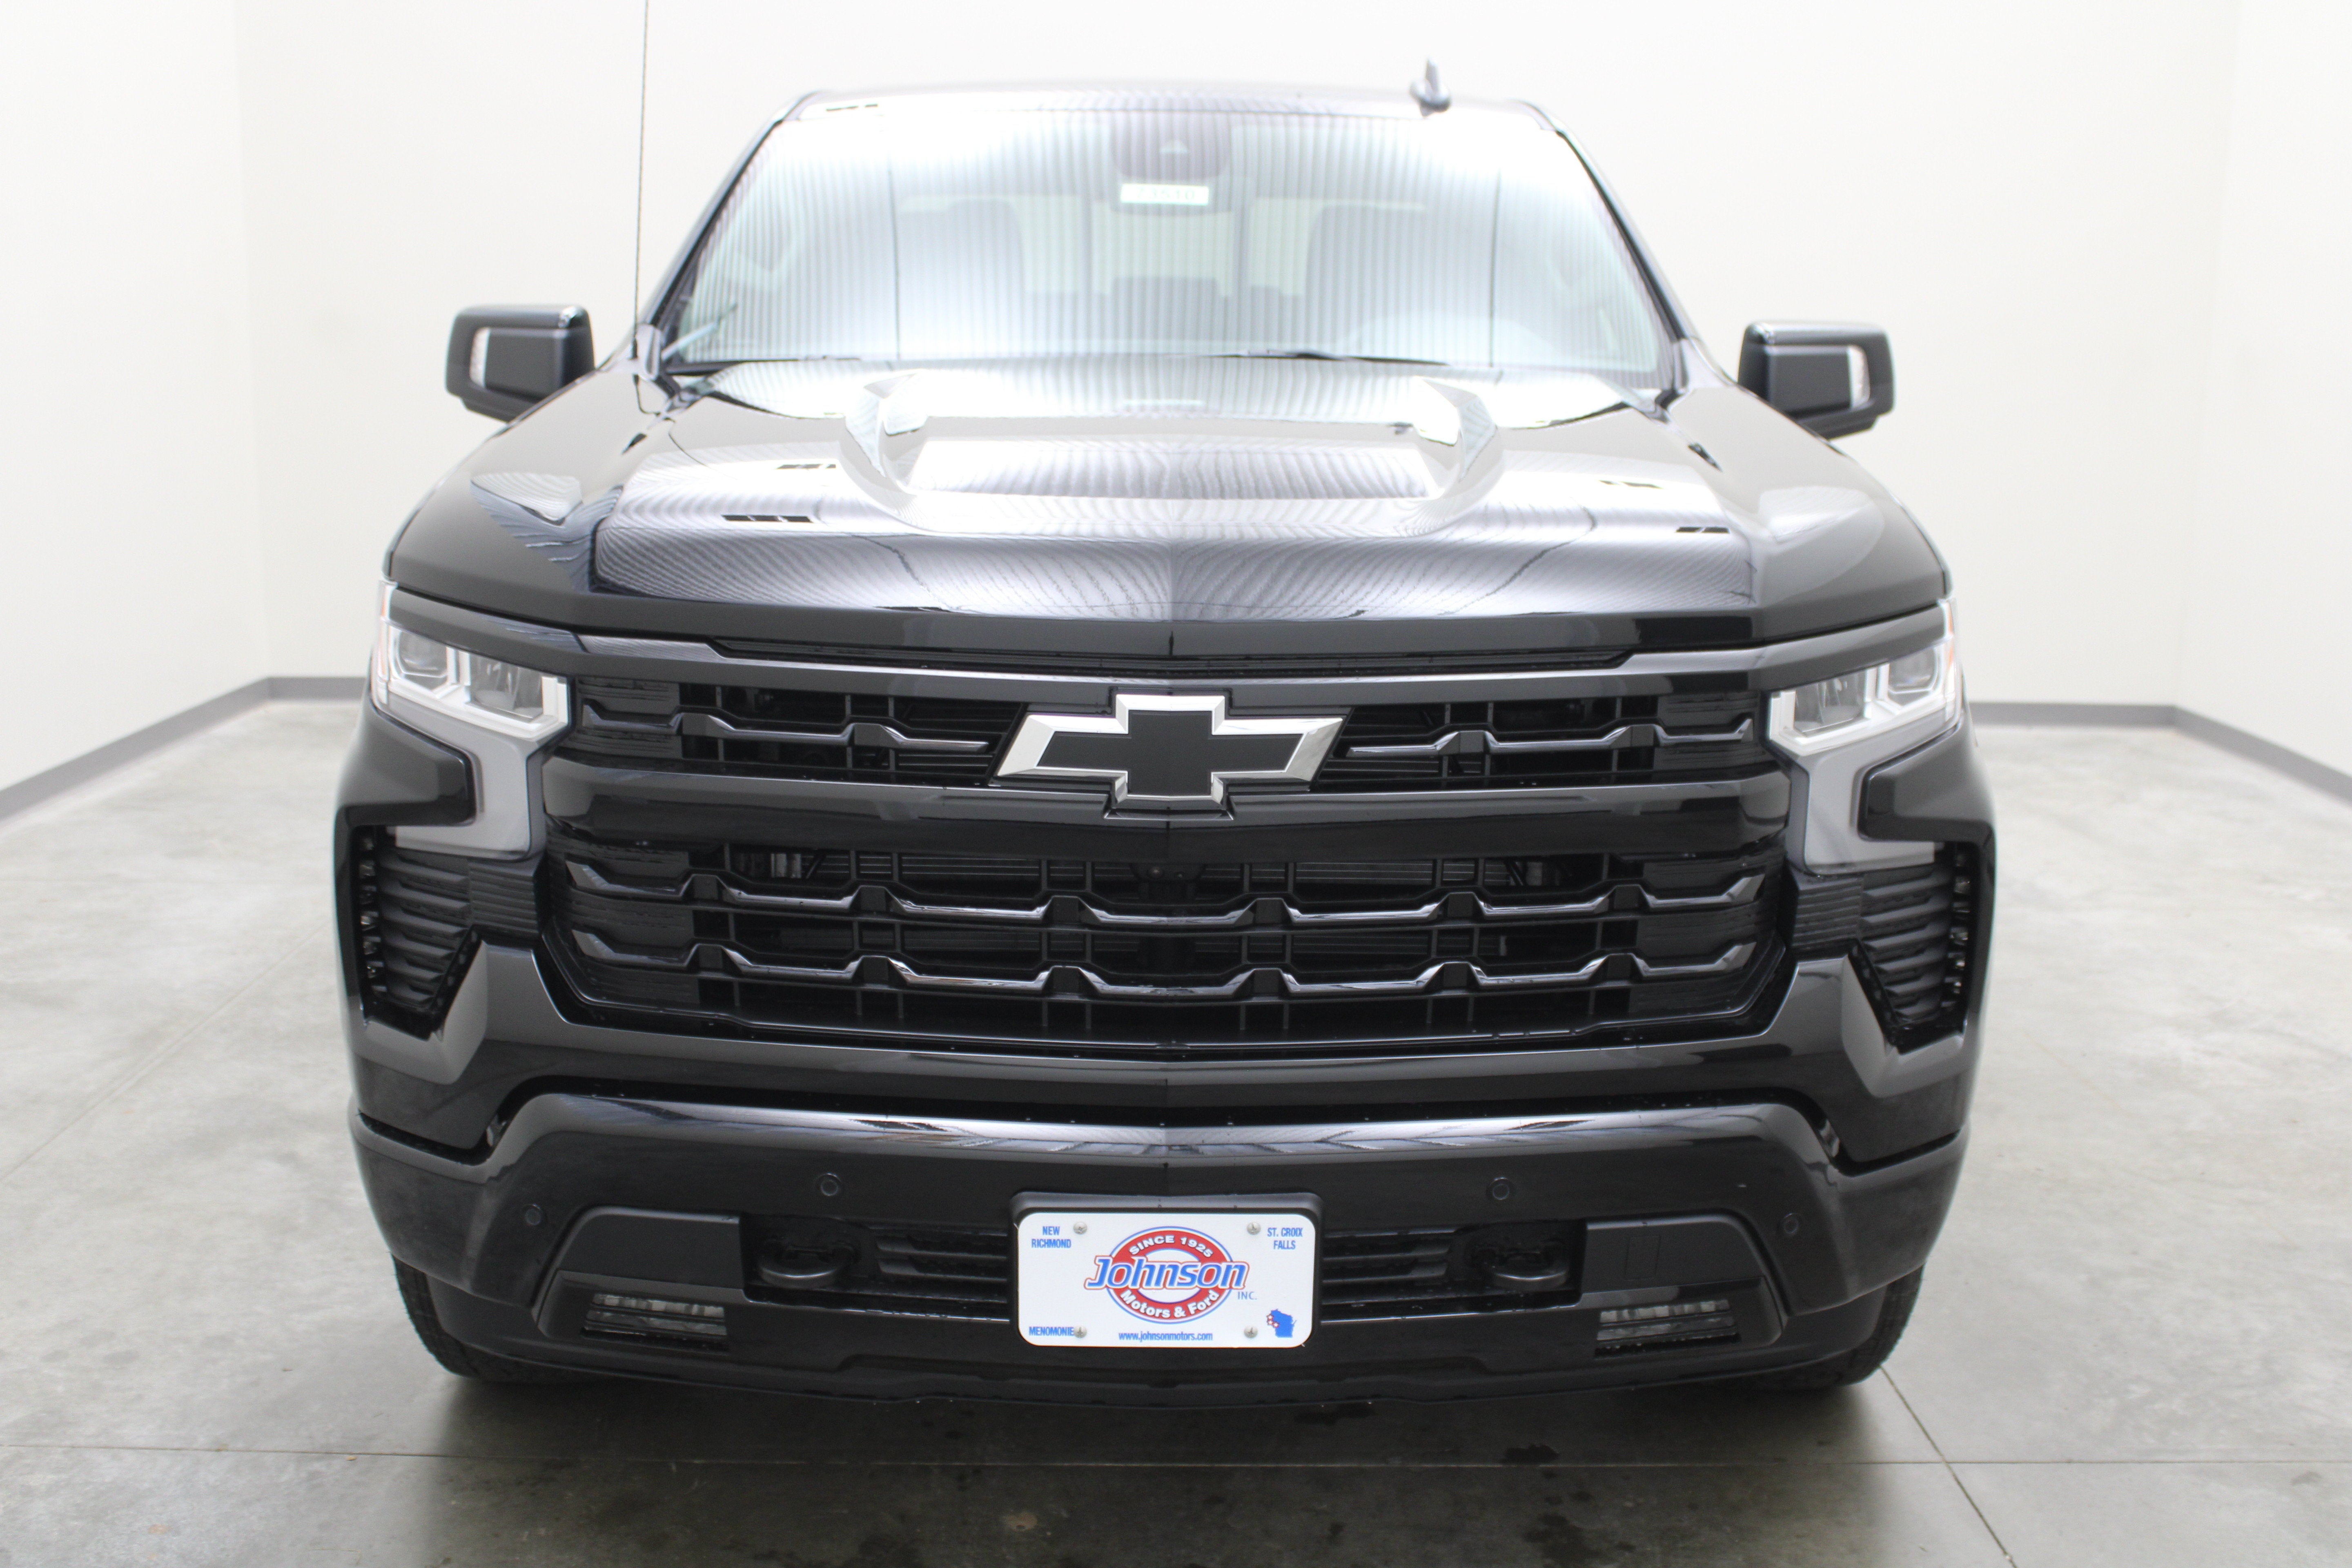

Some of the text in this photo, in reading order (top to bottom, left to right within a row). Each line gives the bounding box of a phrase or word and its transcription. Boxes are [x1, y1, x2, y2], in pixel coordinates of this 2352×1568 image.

[1042, 1226, 1060, 1235] NEW
[1267, 1227, 1303, 1237] ST. CROIX
[1031, 1239, 1071, 1248] RICHMOND
[1129, 1235, 1214, 1258] SINCE 1925
[1273, 1240, 1296, 1250] FALLS
[1085, 1257, 1248, 1289] Johnson
[1238, 1292, 1257, 1300] INC.
[1120, 1290, 1220, 1318] Motors & Ford
[1029, 1327, 1074, 1336] MENOMONIE
[1119, 1331, 1213, 1342] www.johnsonmotors.com
